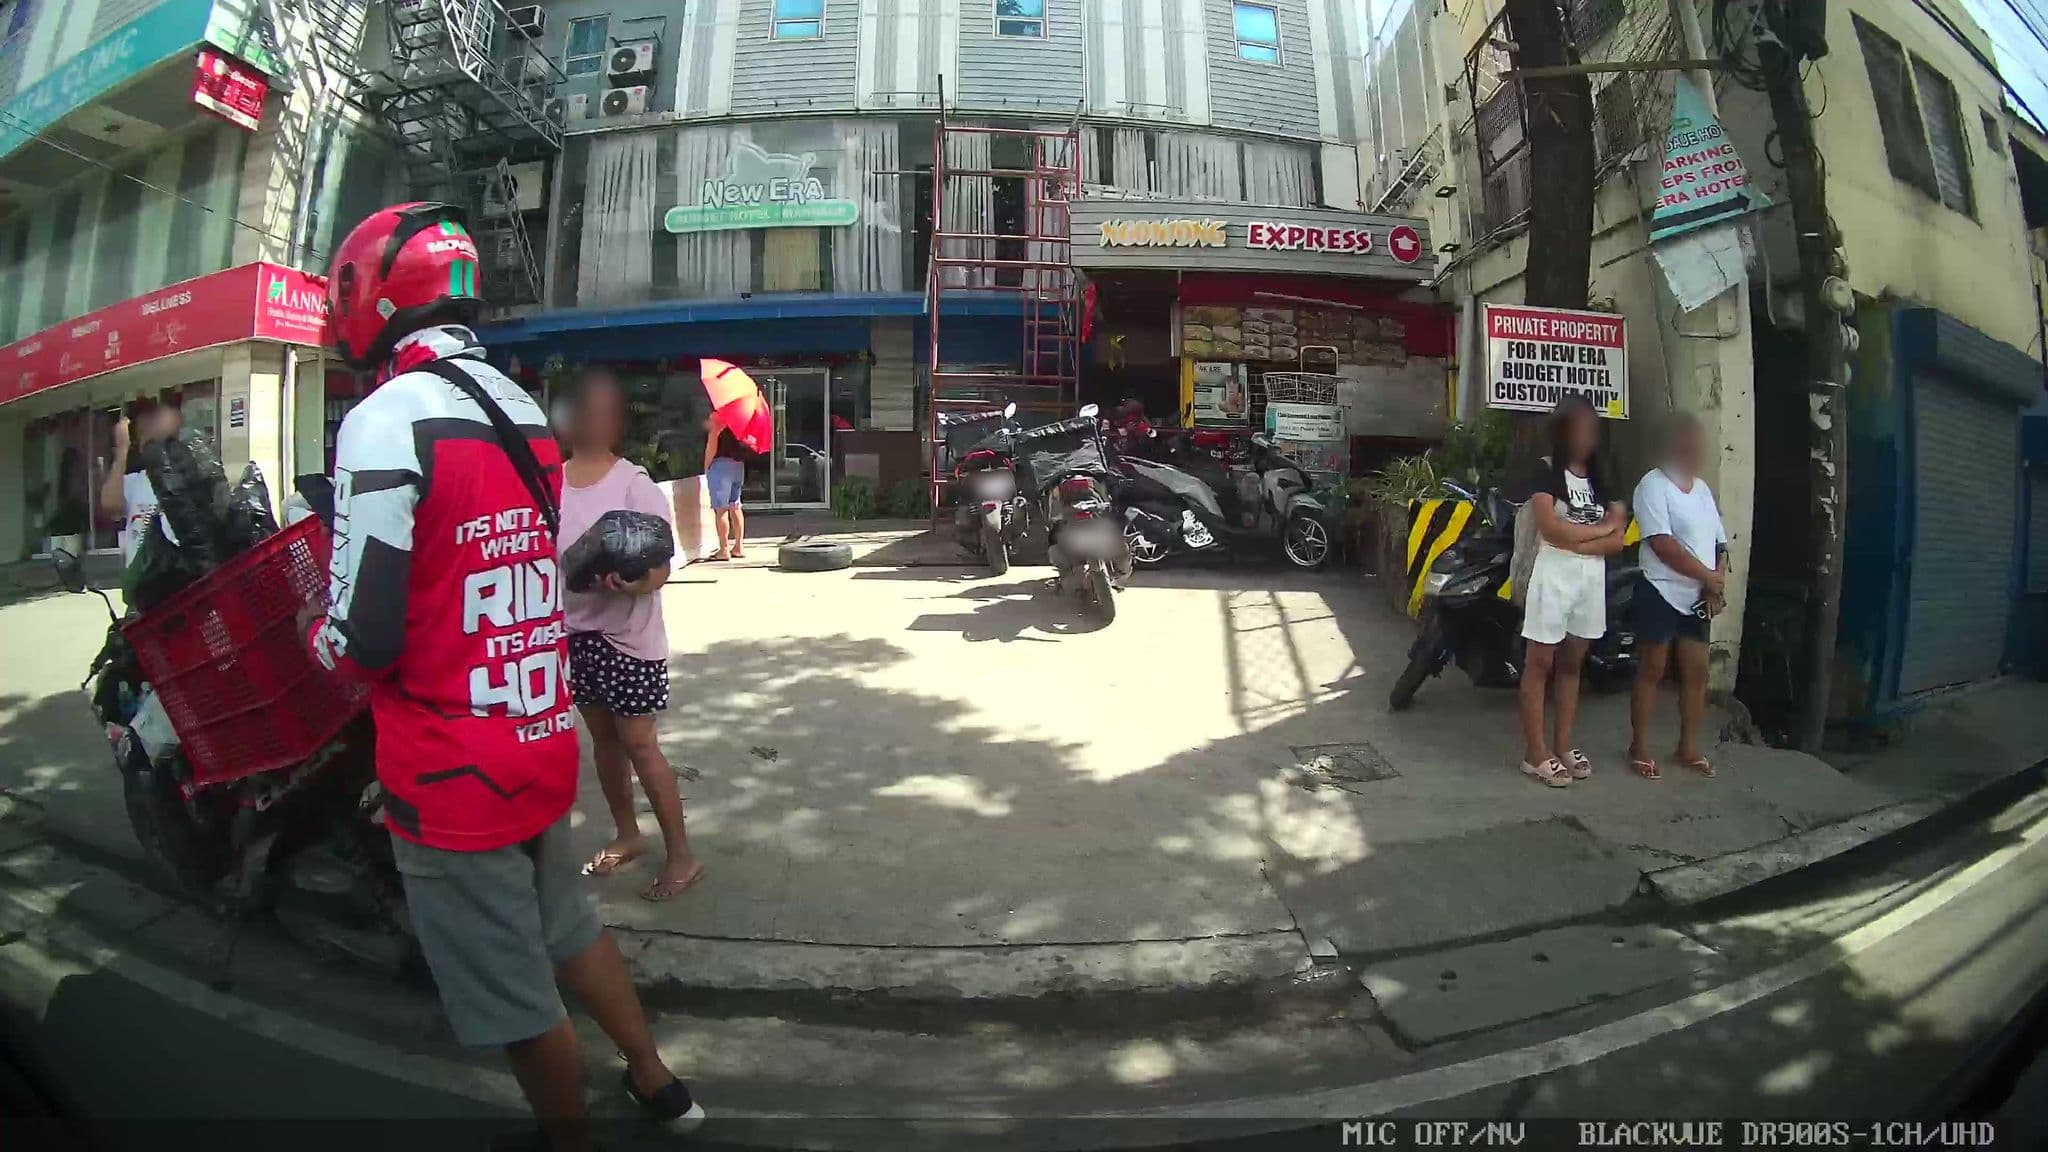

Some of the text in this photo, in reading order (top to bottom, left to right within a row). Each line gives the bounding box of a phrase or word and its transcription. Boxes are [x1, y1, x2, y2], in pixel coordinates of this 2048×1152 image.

[769, 177, 823, 206] ERA
[1656, 191, 1690, 209] ERA
[1248, 222, 1371, 253] EXPRESS
[266, 272, 329, 315] MANNA
[1494, 315, 1617, 342] PRIVATE PROPERTY
[1507, 341, 1607, 366] FOR NEW ERA
[1503, 362, 1612, 387] BUDGET HOTEL
[456, 515, 491, 544] ITS
[495, 508, 532, 533] NOT
[480, 531, 539, 560] WHAT
[486, 631, 524, 658] ITS
